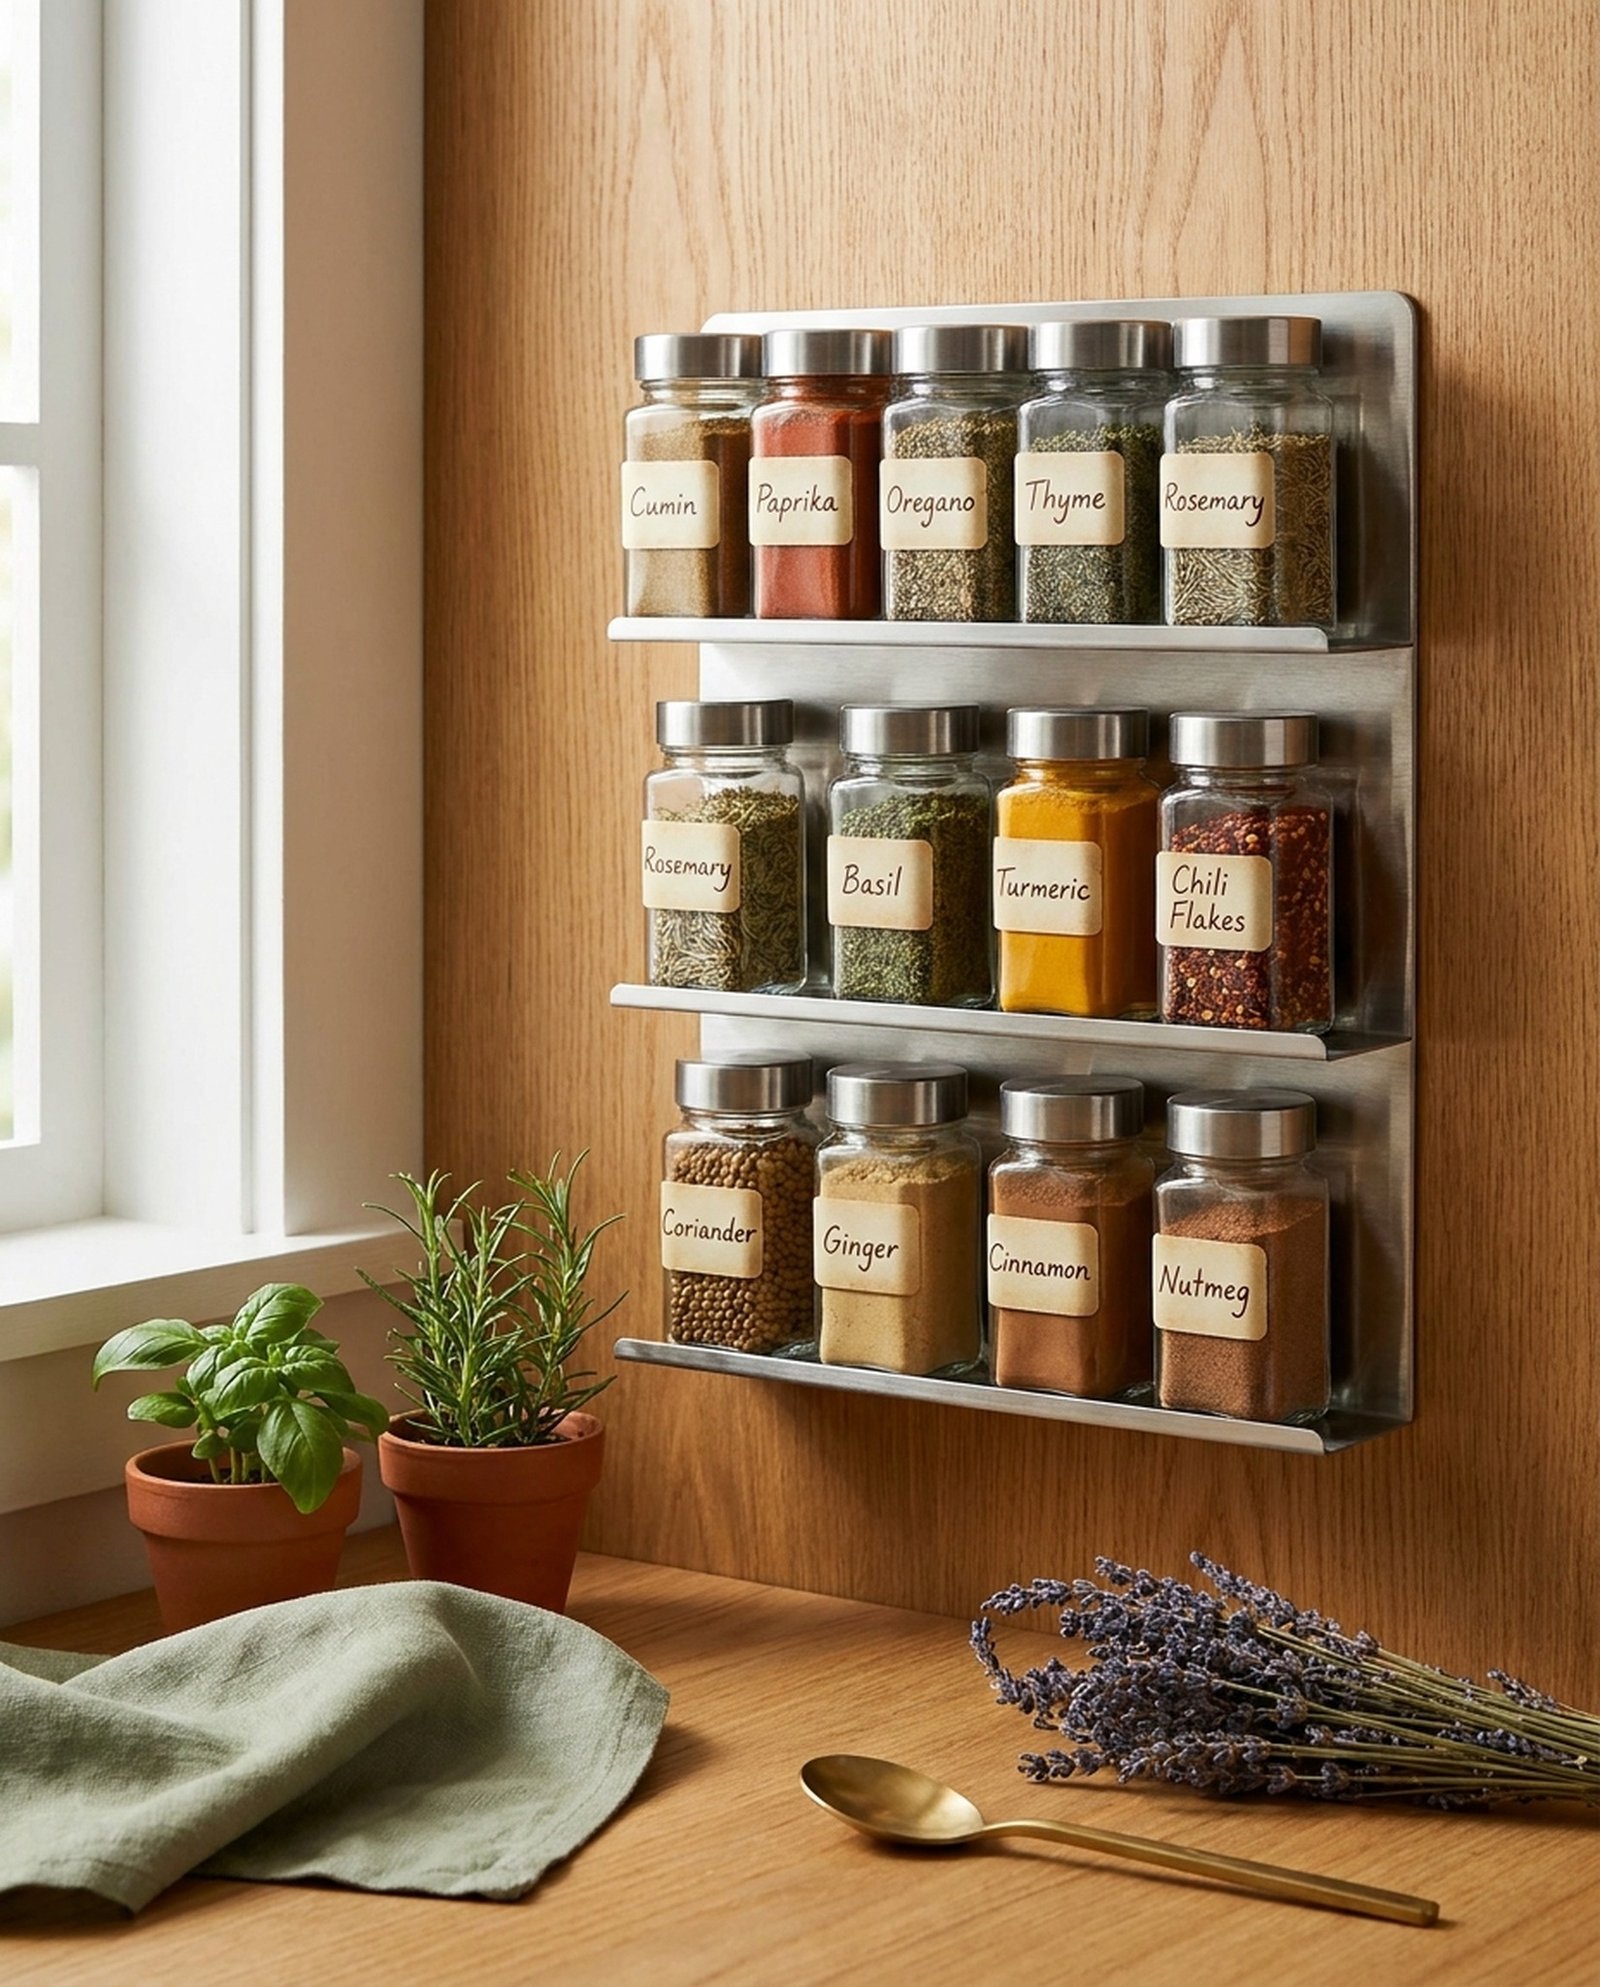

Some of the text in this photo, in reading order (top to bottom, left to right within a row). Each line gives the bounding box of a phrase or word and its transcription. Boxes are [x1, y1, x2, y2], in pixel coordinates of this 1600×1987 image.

[630, 486, 697, 517] Cumin
[756, 483, 839, 523] Paprika
[887, 485, 976, 528] Oregano
[1025, 479, 1106, 524] Thyme
[1164, 482, 1265, 527] Rosemary
[644, 846, 732, 893] Rosemary
[842, 863, 903, 897] Basil
[997, 867, 1091, 901] Turmeric
[1172, 864, 1229, 896] Chili
[1170, 900, 1246, 932] Flakes
[663, 1208, 757, 1243] Coriander
[823, 1225, 899, 1272] Ginger
[989, 1243, 1091, 1281] Cinnamon
[1158, 1264, 1250, 1318] Nutmeg
